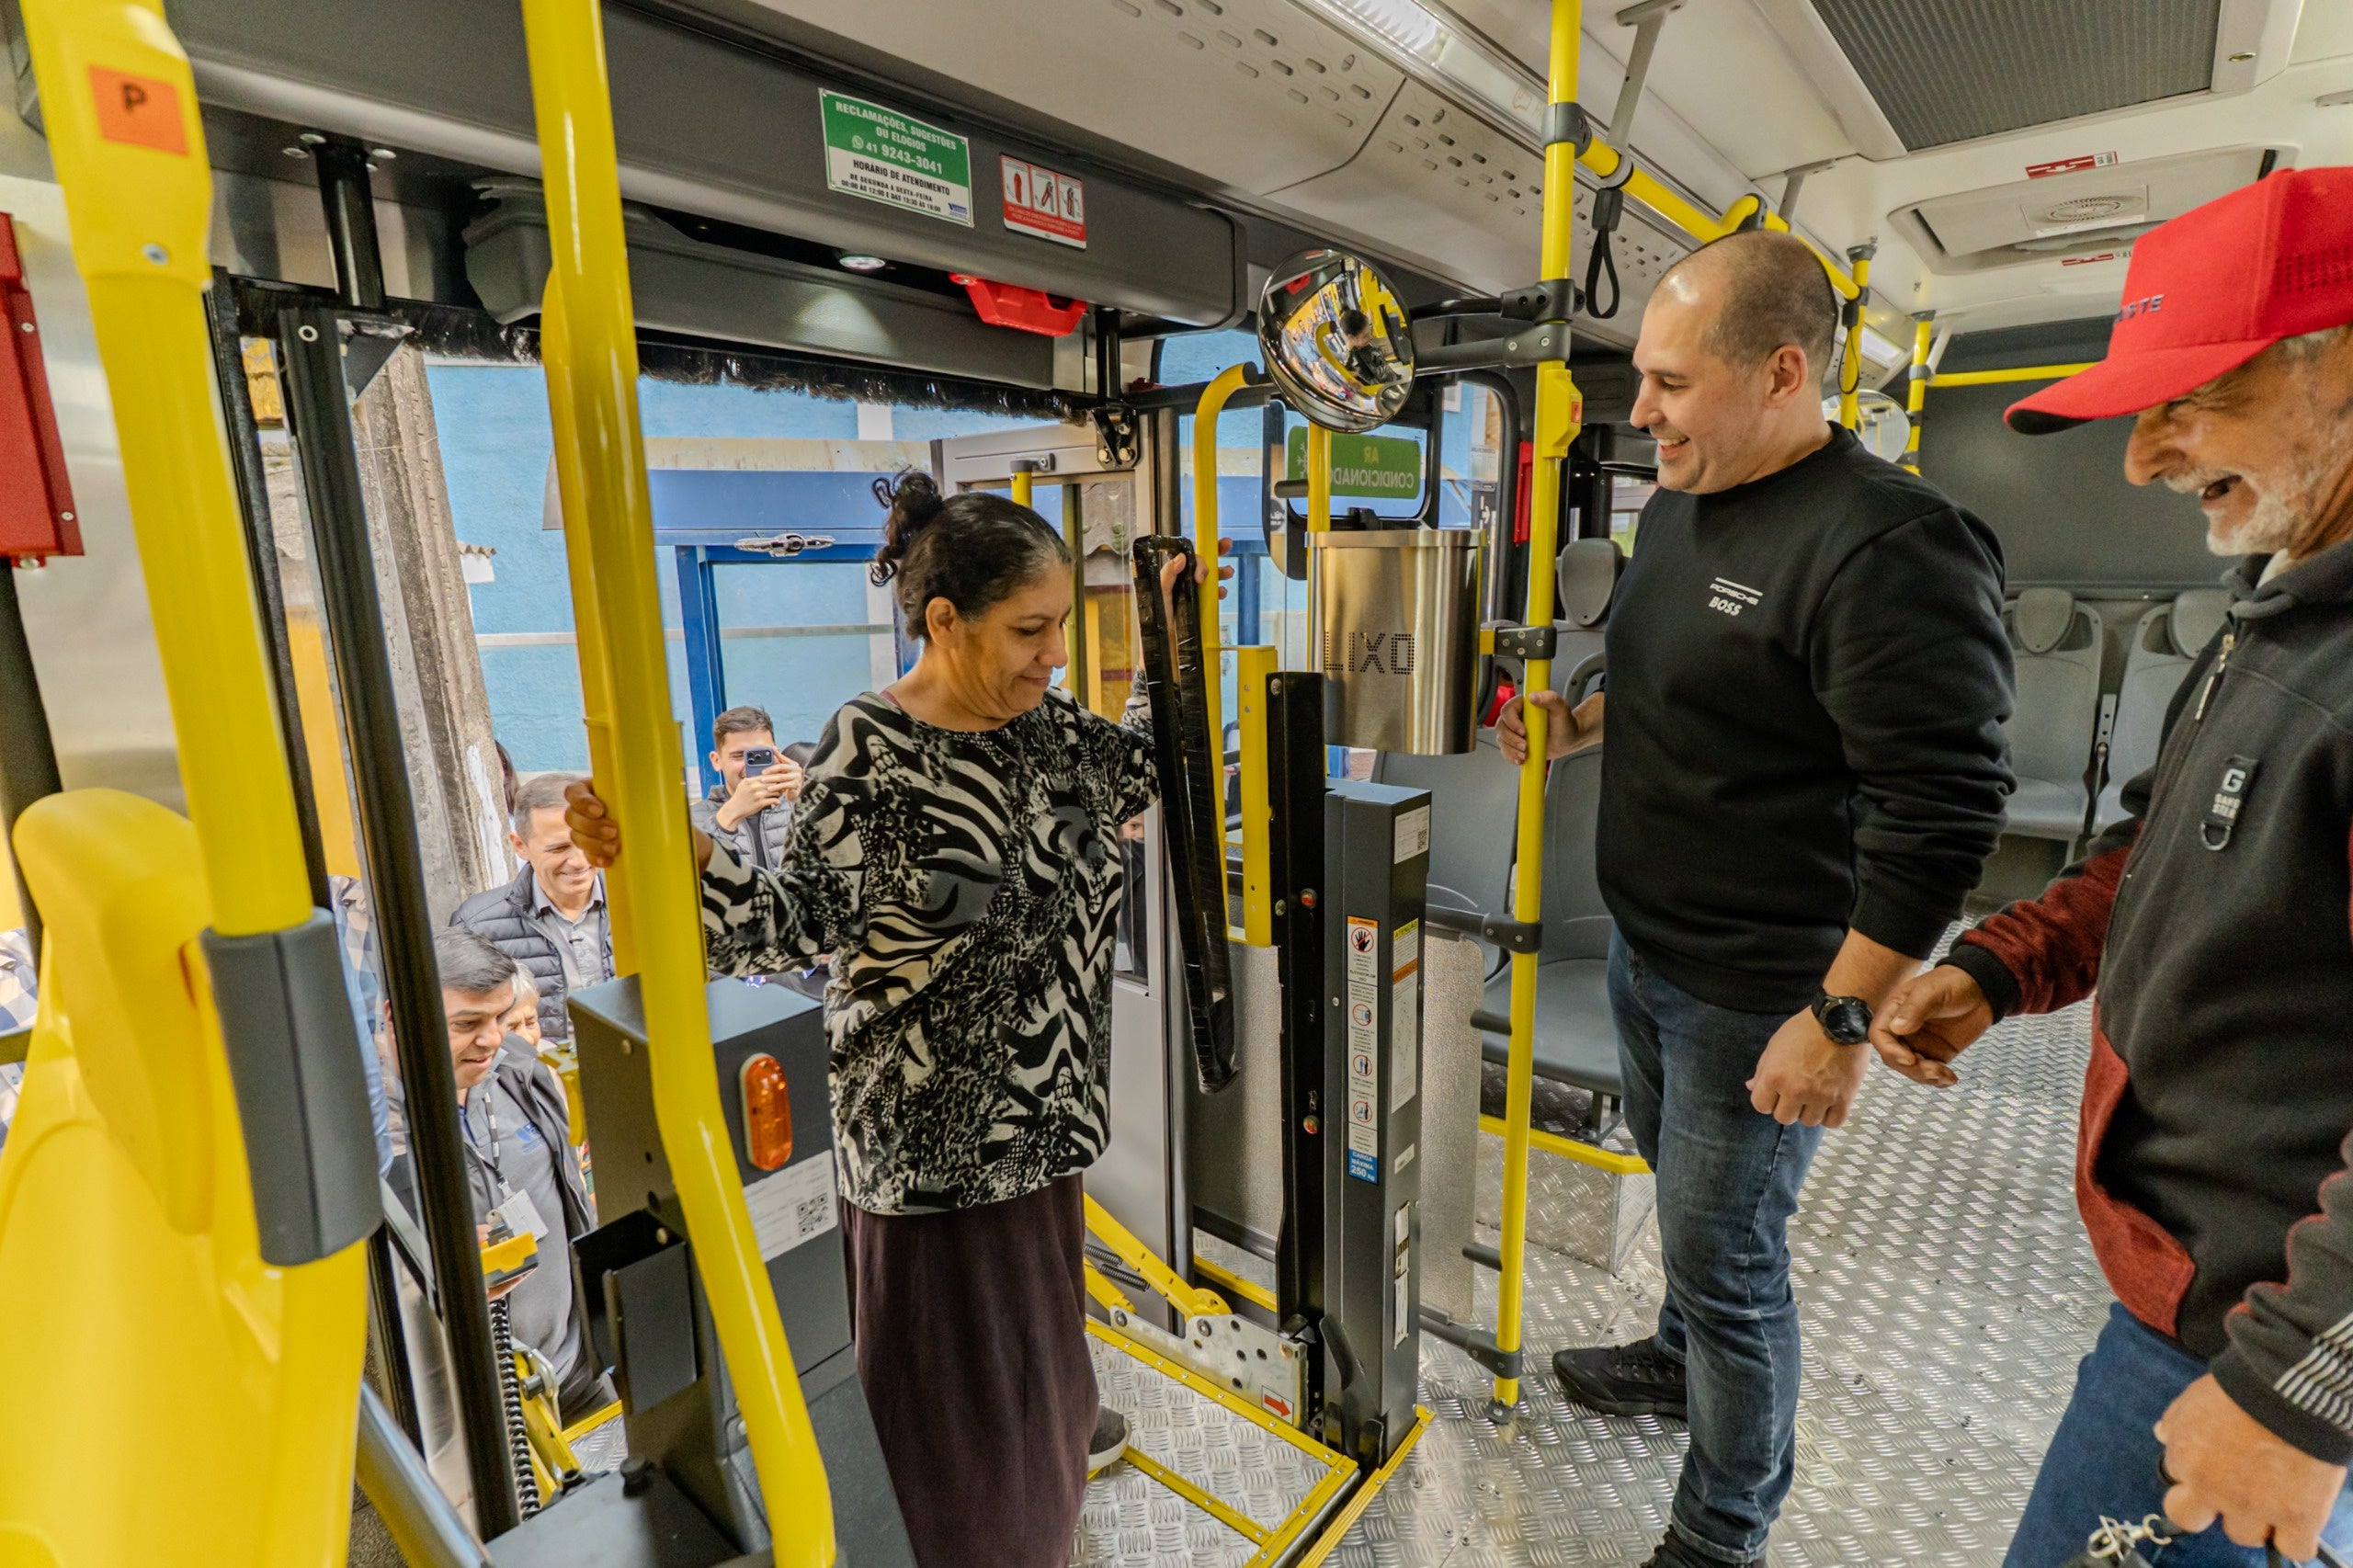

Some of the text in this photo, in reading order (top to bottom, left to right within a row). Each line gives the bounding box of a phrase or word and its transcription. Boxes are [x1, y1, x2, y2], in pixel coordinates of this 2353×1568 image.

[122, 83, 147, 111] P
[835, 101, 957, 151] RECLAMAÇÕES, SUGESTÕES
[876, 126, 926, 153] OU ELOGIOS
[866, 142, 942, 175] 41 9243-3041
[849, 173, 858, 181] DE
[859, 176, 889, 190] SEGUNDA
[896, 186, 932, 202] SEXTA-FEIRA
[853, 159, 950, 196] HORÁRIO DE ATENDIMENTO
[1709, 596, 1743, 617] BOSS
[1324, 631, 1415, 676] LIXO
[2222, 767, 2246, 793] G
[1351, 1158, 1374, 1171] MÁXIMA
[1352, 1151, 1373, 1163] CARGA
[1351, 1165, 1367, 1177] 250
